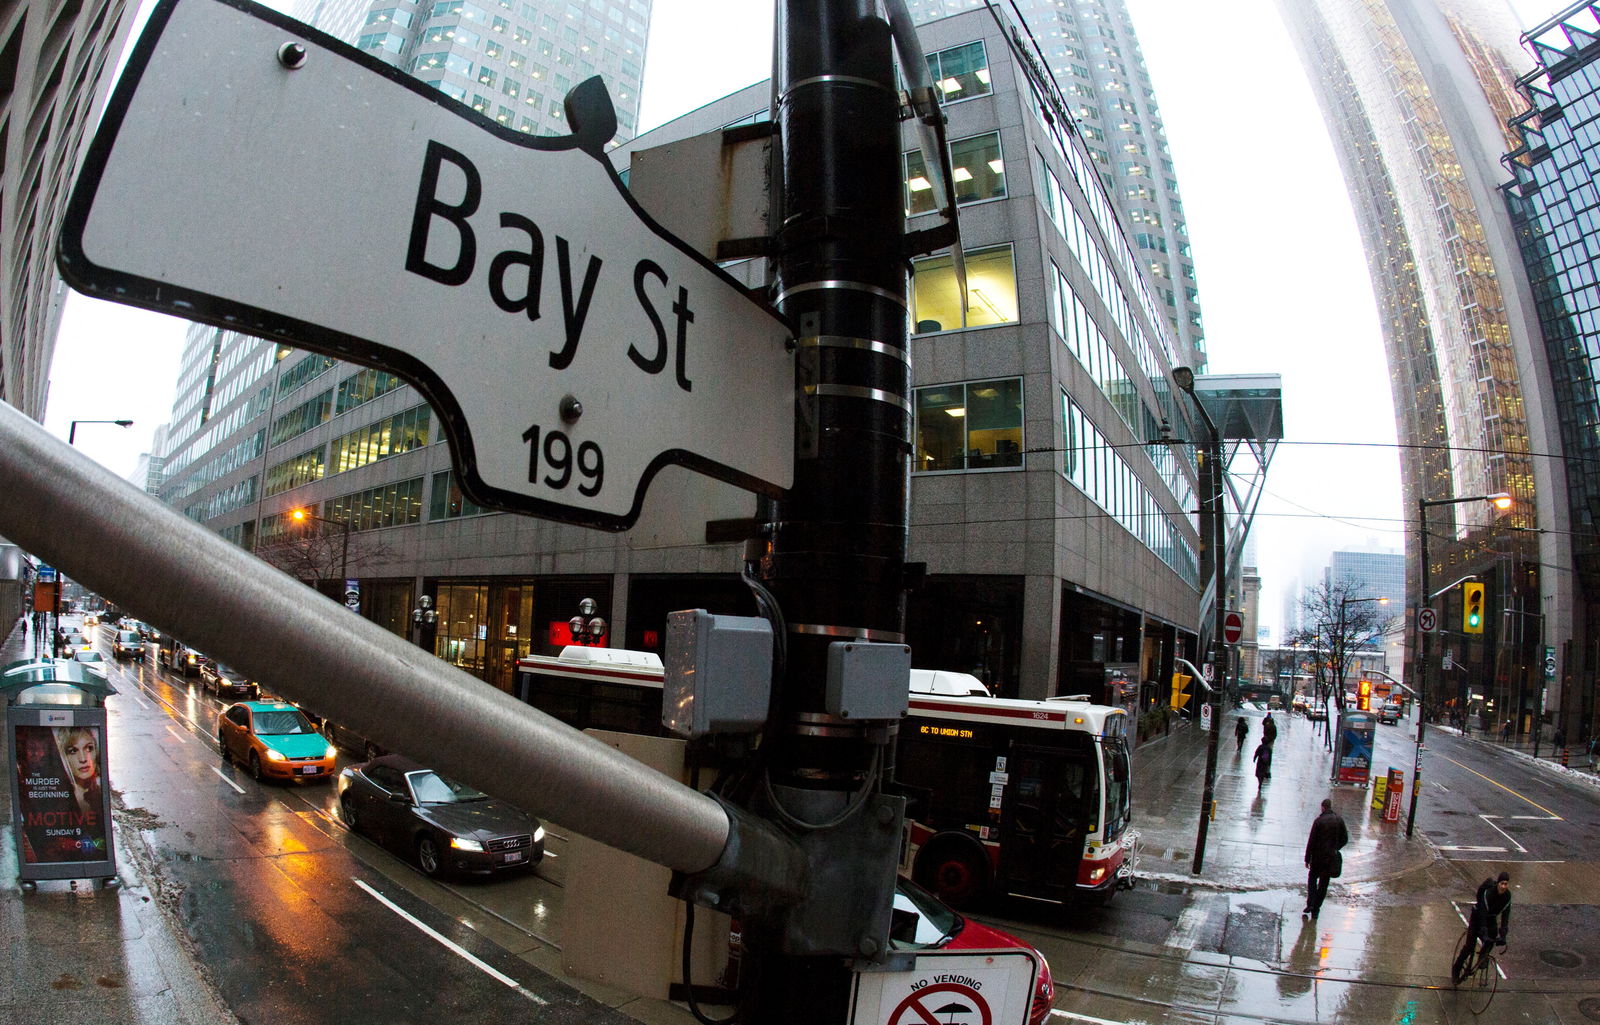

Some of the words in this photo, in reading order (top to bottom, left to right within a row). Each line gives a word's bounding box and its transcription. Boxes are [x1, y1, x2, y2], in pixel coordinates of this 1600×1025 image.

[405, 139, 603, 371] Bay
[627, 258, 695, 393] St
[522, 424, 604, 498] 199
[1032, 711, 1048, 720] 1624
[920, 725, 929, 734] 6C
[931, 726, 939, 735] TO
[940, 727, 959, 737] UNION
[960, 730, 973, 738] STN
[25, 777, 60, 786] MURDER
[28, 791, 70, 799] BEGINNING
[27, 811, 97, 827] MOTIVE
[76, 828, 81, 836] 9
[910, 979, 928, 992] NO
[933, 974, 982, 991] VENDING
